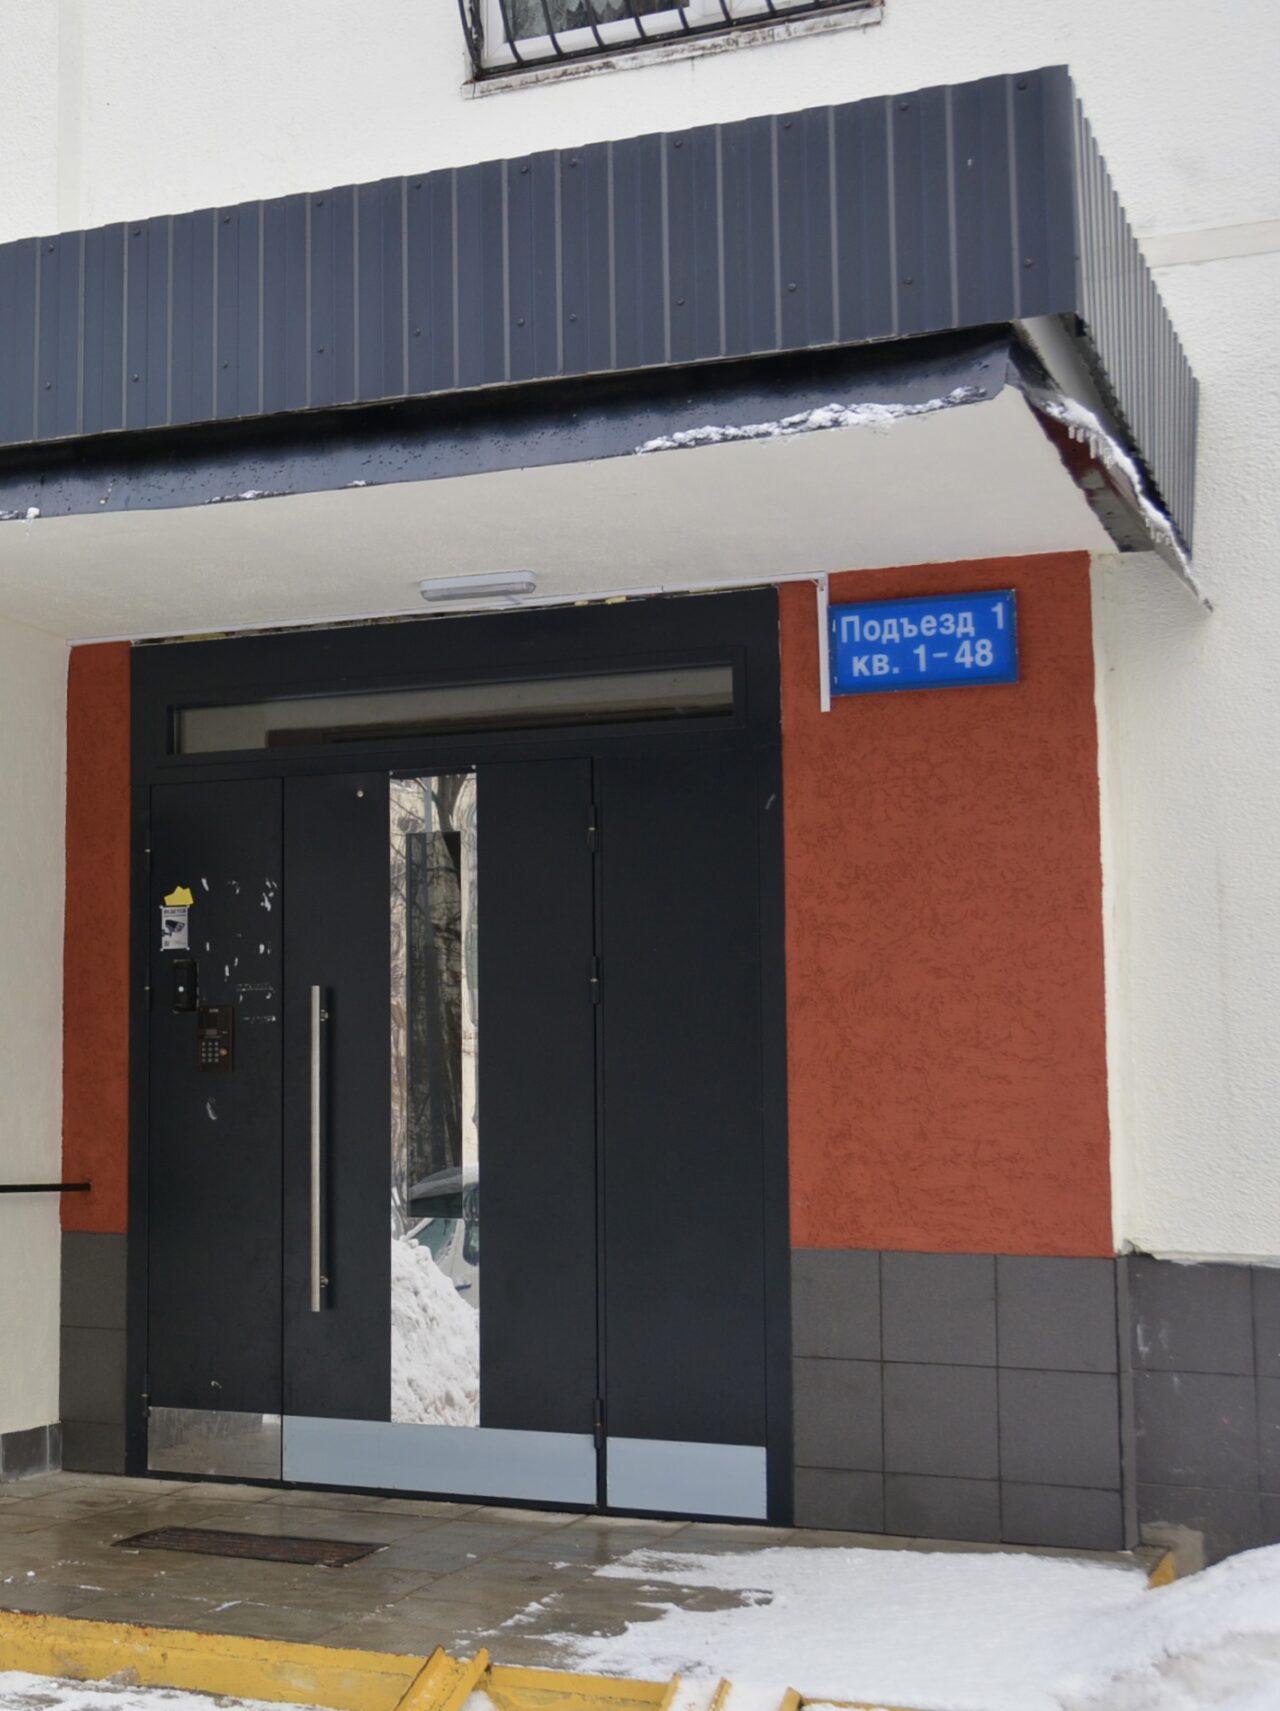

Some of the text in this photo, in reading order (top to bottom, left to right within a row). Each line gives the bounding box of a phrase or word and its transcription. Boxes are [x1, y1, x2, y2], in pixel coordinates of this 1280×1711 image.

[841, 602, 1004, 644] Подъезд 1
[852, 638, 994, 677] кв. 1-48
